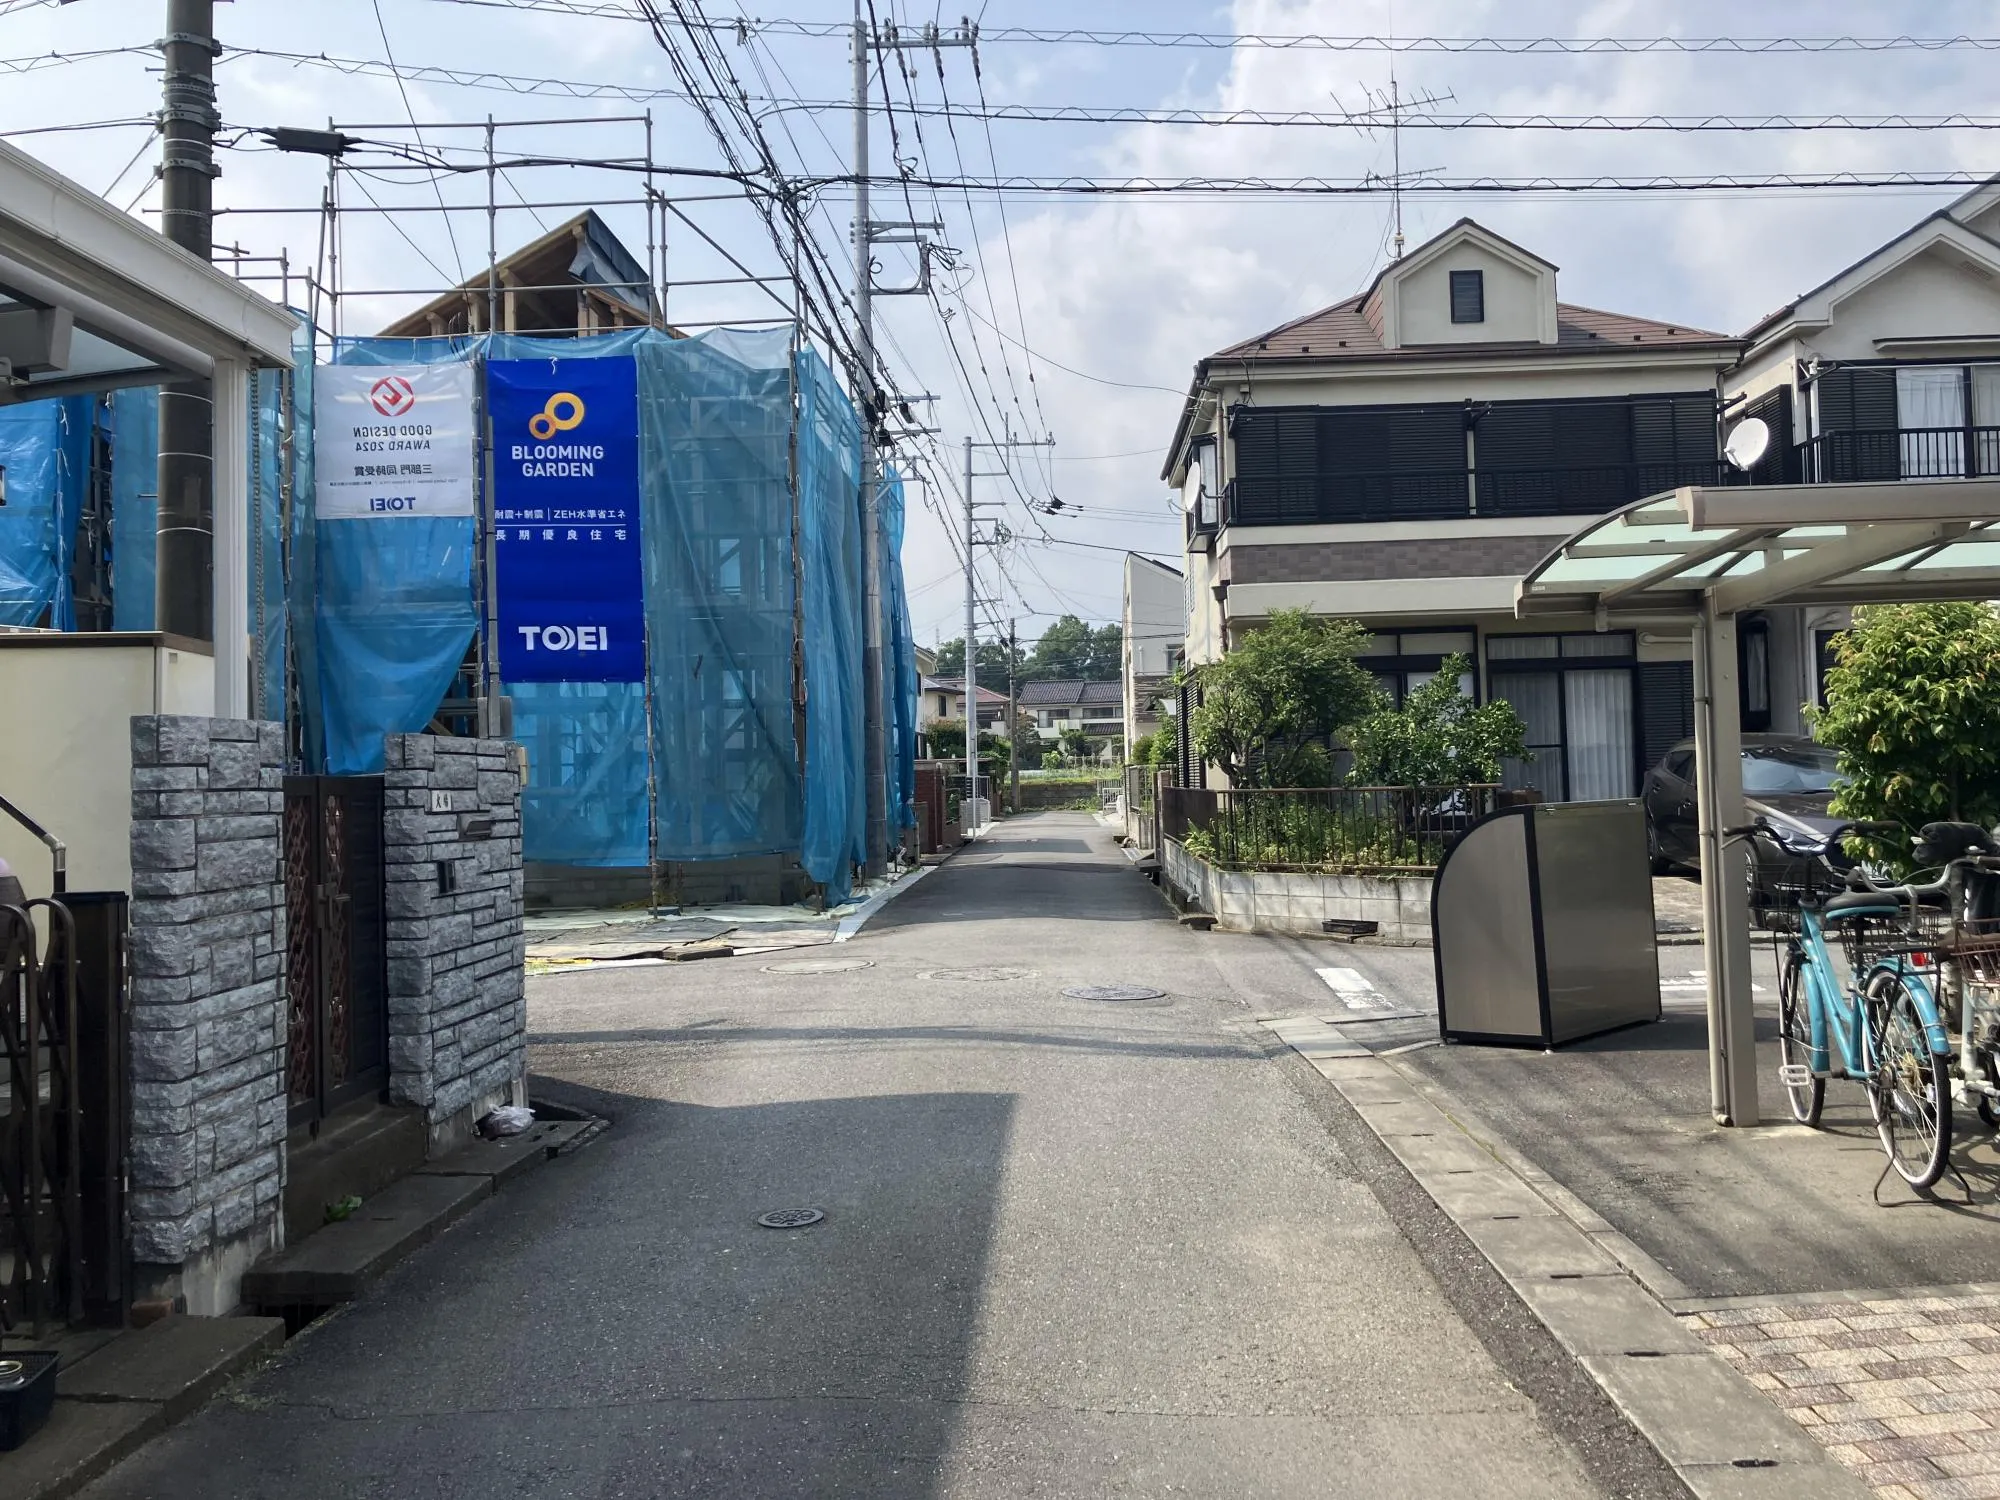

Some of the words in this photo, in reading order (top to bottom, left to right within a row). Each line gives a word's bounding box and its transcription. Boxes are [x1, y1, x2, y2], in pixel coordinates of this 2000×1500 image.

[511, 445, 604, 460] BLOOMING
[522, 462, 594, 477] GARDEN
[494, 529, 627, 541] 長期優良住宅
